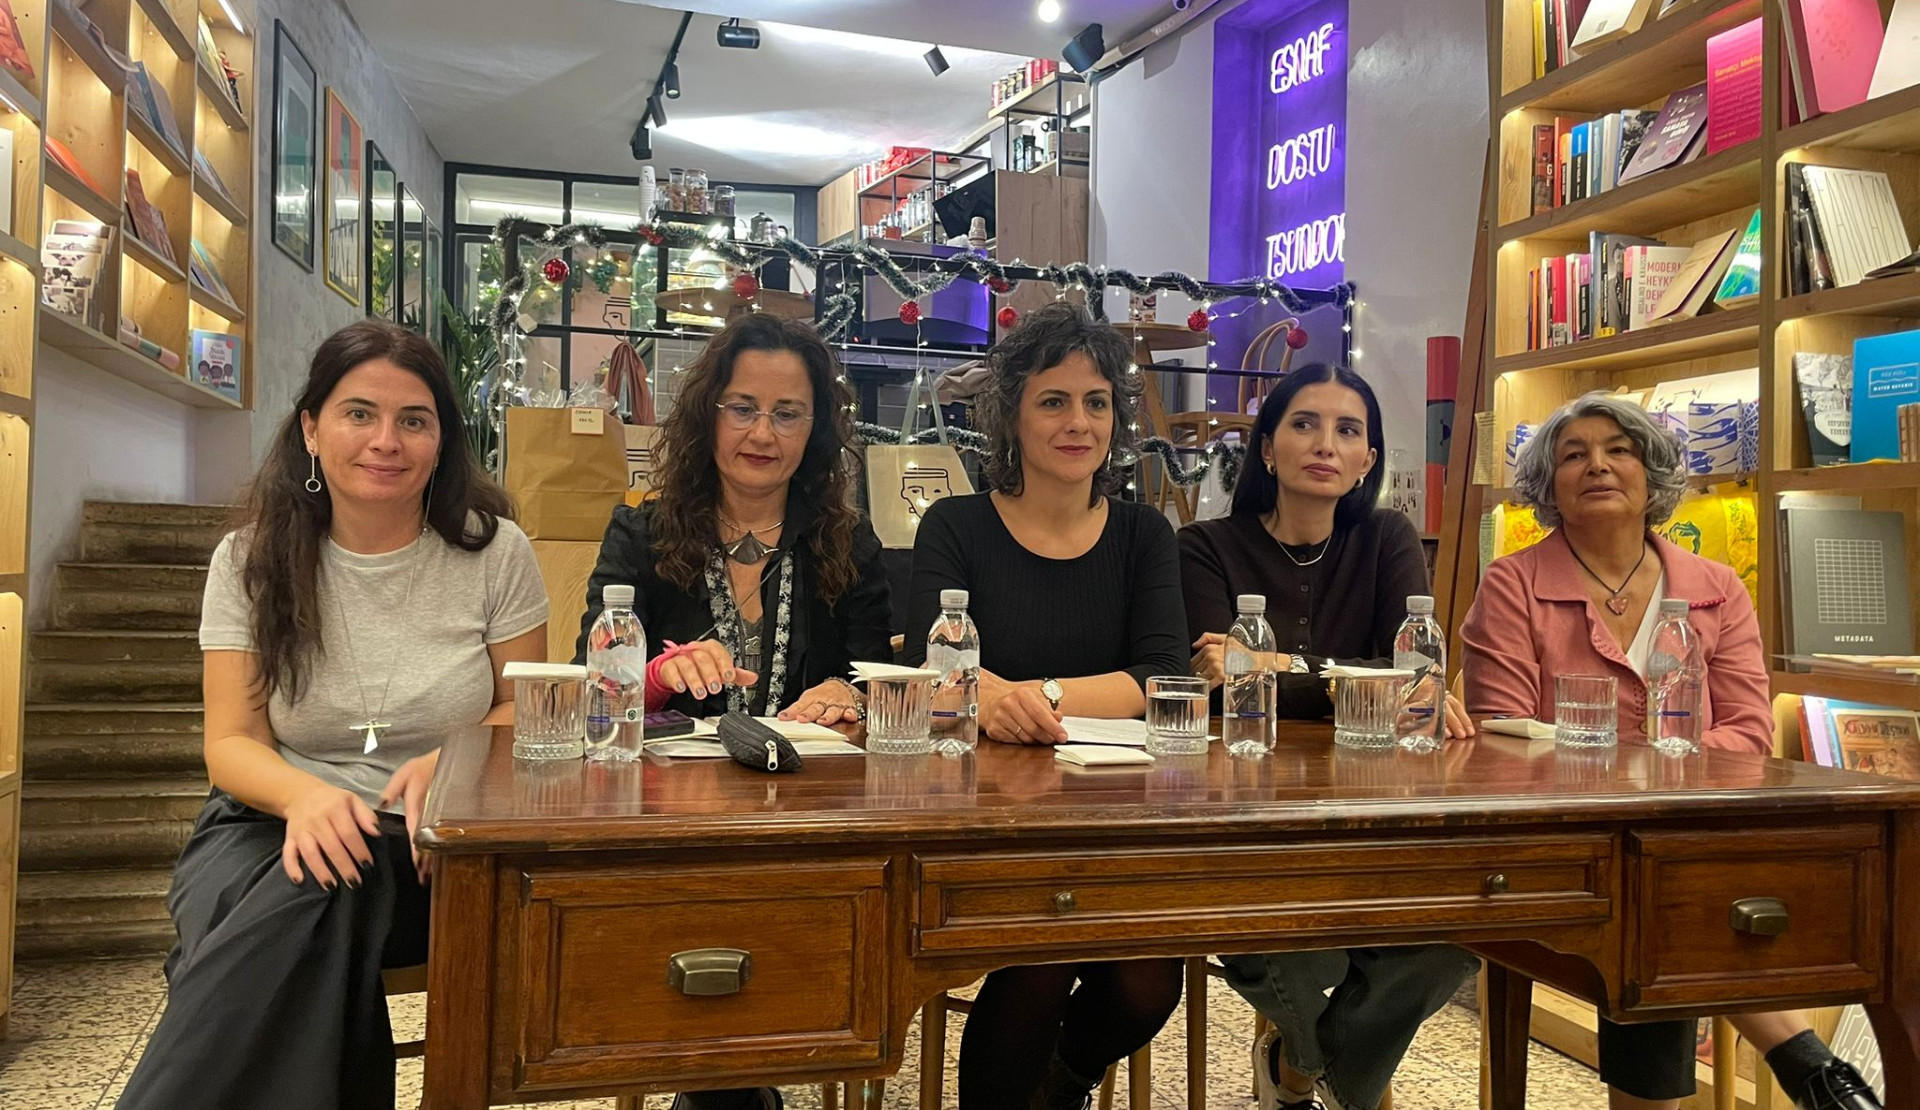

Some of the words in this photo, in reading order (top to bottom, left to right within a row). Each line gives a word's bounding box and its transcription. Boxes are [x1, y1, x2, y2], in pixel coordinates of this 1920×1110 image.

[1270, 22, 1334, 94] ESNAF
[1266, 124, 1334, 190] DOSTU
[1834, 635, 1874, 643] METADATA
